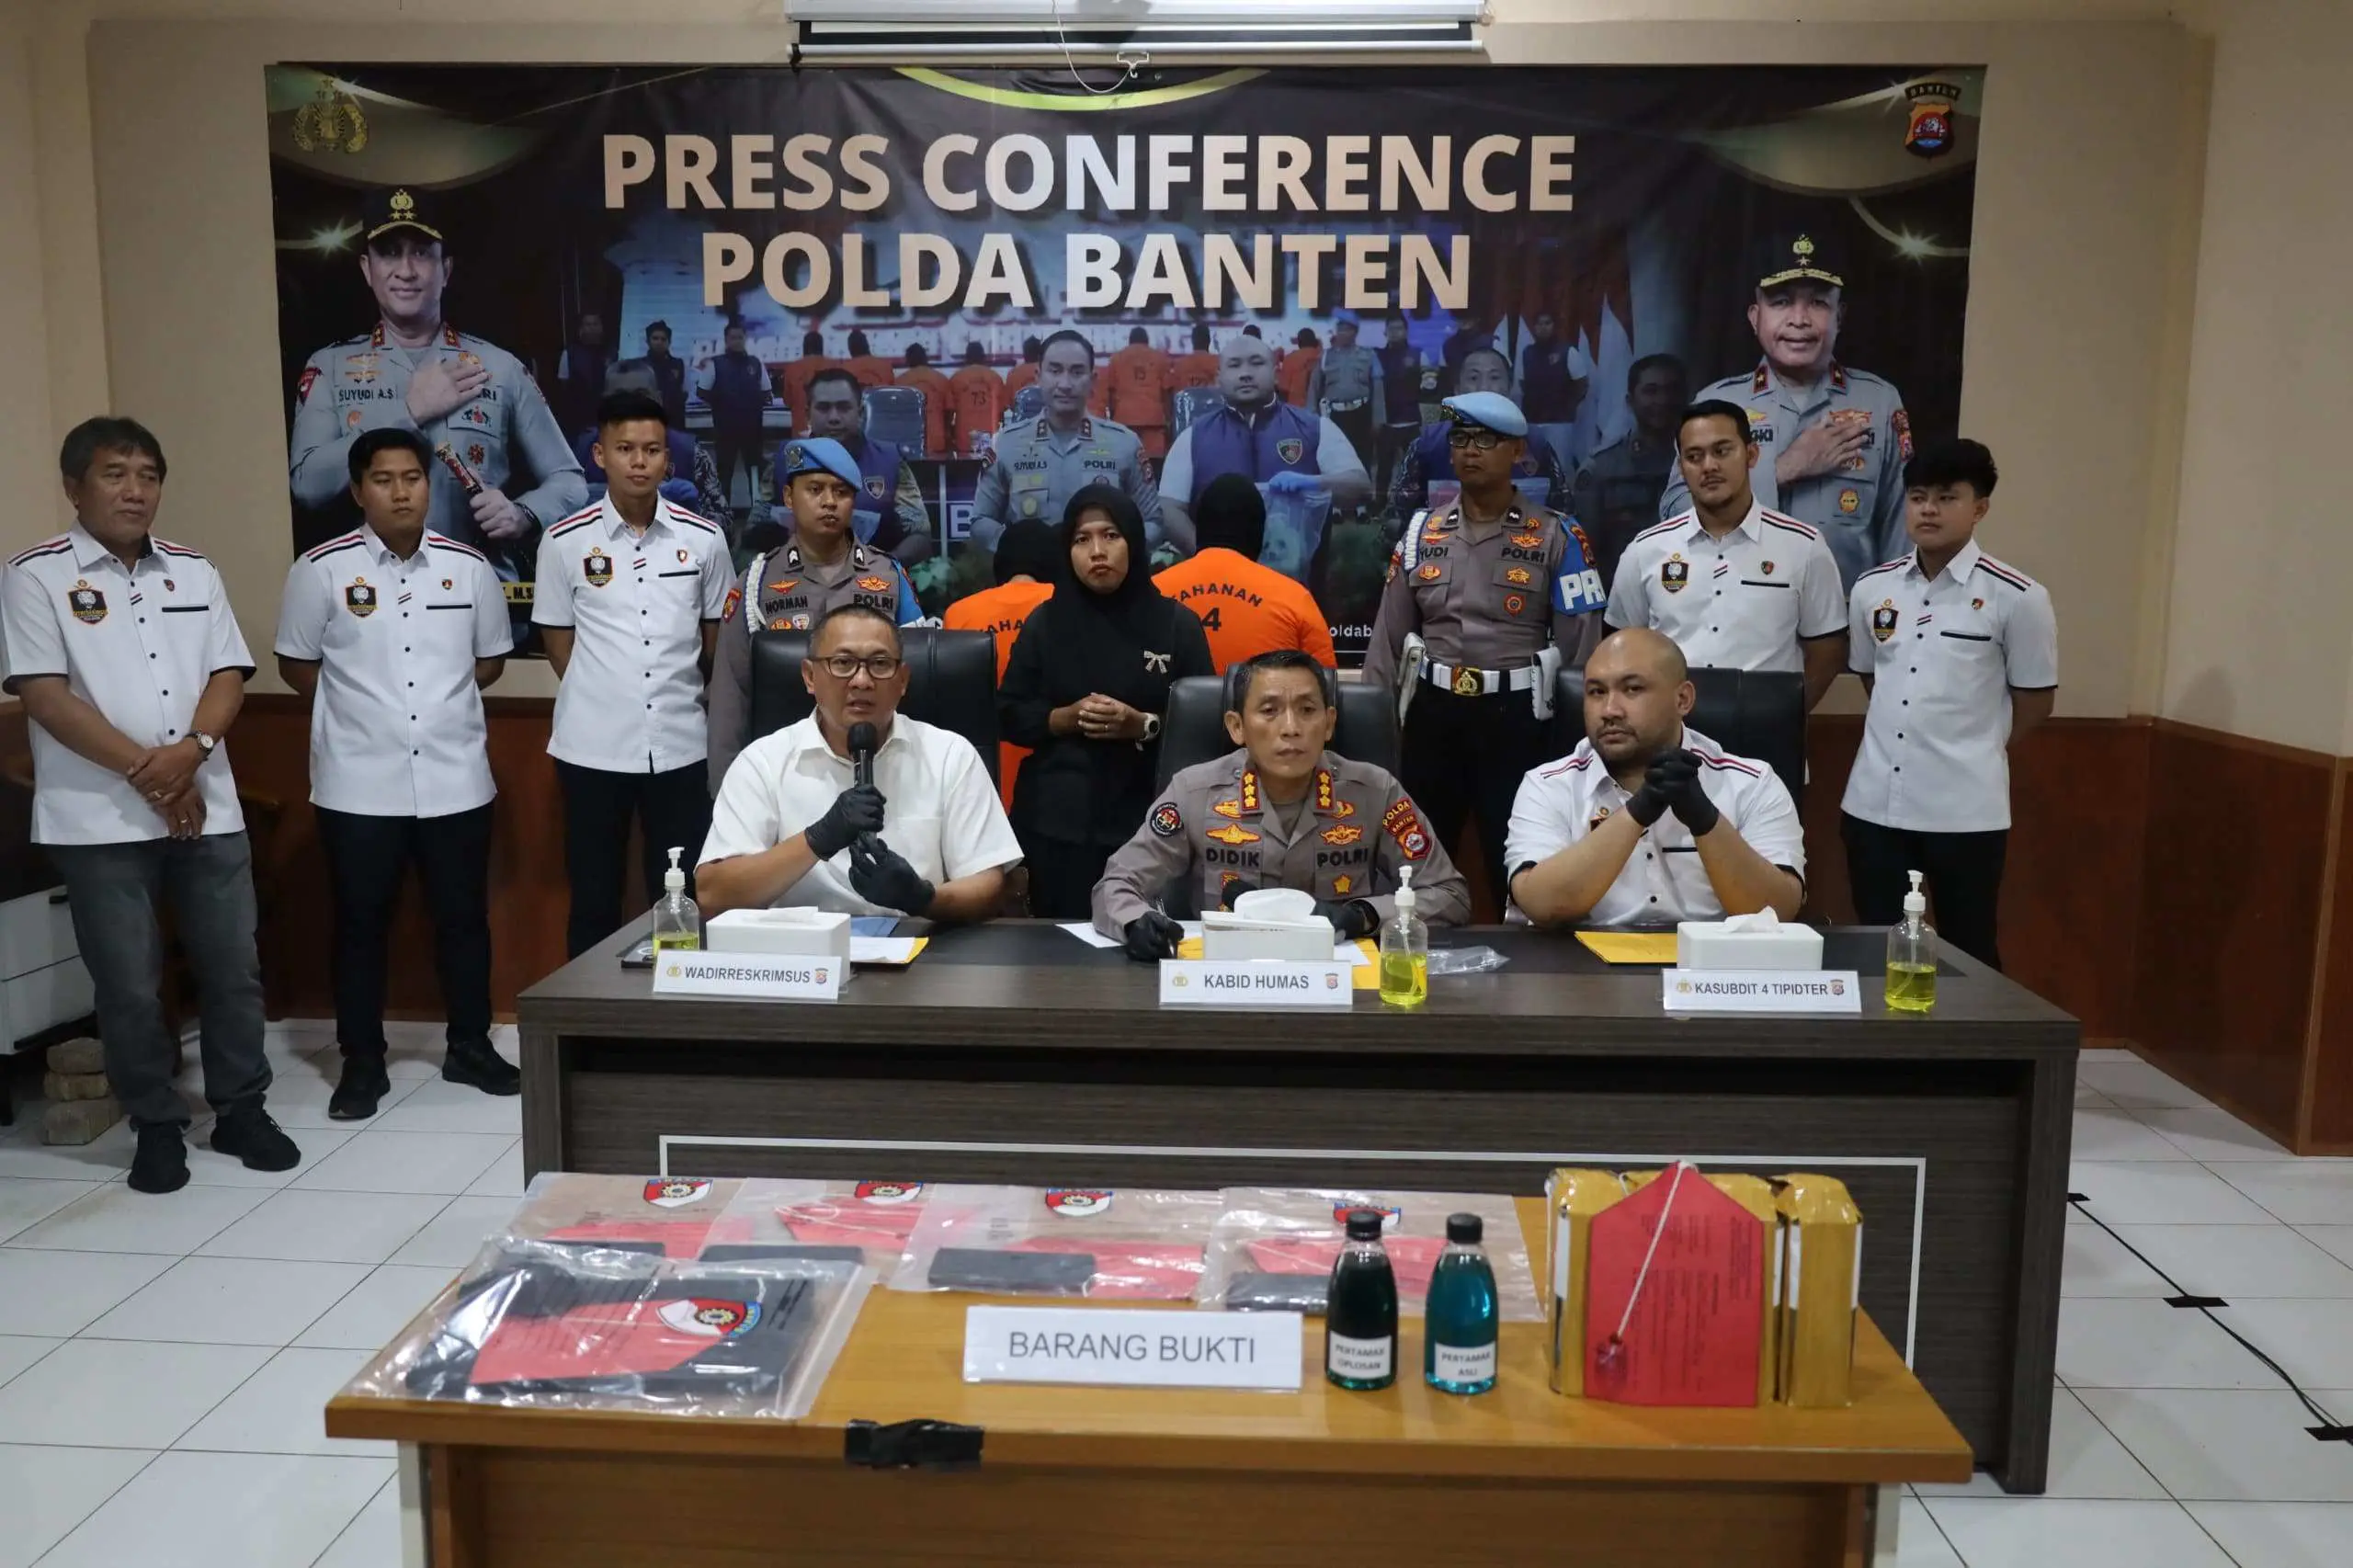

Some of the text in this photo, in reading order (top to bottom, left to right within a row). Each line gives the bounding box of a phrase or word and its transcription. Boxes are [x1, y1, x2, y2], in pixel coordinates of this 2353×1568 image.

[604, 133, 1576, 212] PRESS CONFERENCE
[703, 232, 1471, 310] POLDA BANTEN
[338, 389, 374, 402] SUYUDI
[1502, 547, 1545, 564] POLRI
[853, 593, 894, 611] POLRI
[1170, 583, 1263, 608] AHANAN
[765, 596, 809, 614] NORMAN
[1200, 607, 1222, 632] 4
[1381, 801, 1411, 826] POLDA
[1206, 847, 1260, 868] DIDIK
[1316, 847, 1370, 868] POLRI
[684, 966, 811, 983] WADIRRESKRIMSUS
[1204, 974, 1310, 990] KABID HUMAS
[1695, 983, 1828, 996] KASUBDIT 4 TIPIDTER
[1008, 1331, 1256, 1364] BARANG BUKTI
[1337, 1358, 1381, 1369] OPLOSAN
[1458, 1367, 1478, 1377] ASLI
